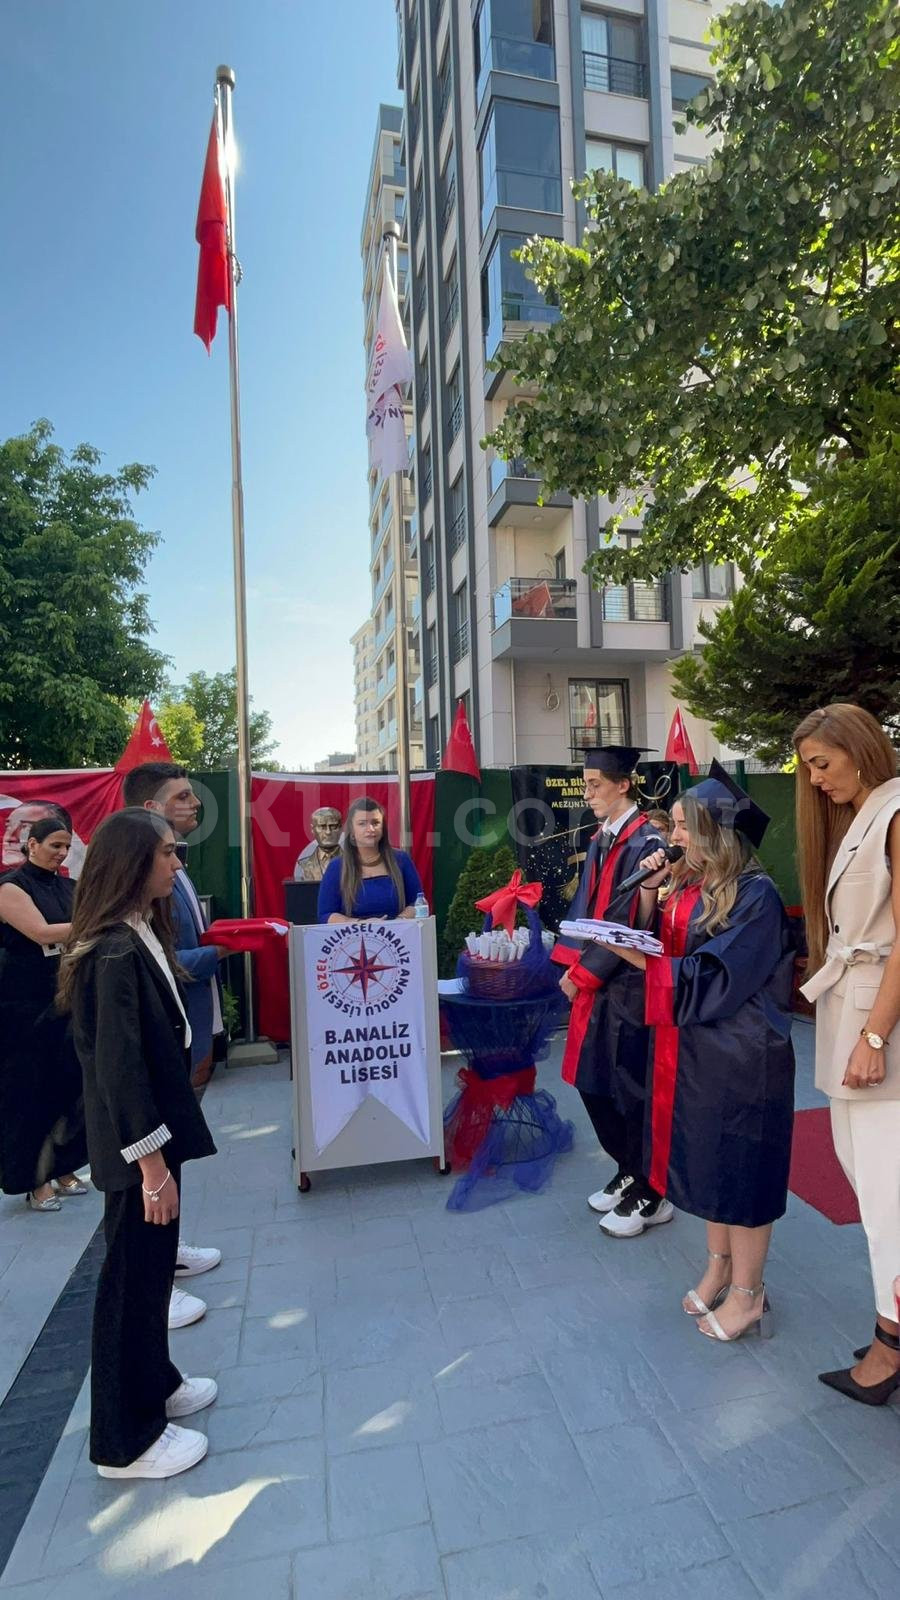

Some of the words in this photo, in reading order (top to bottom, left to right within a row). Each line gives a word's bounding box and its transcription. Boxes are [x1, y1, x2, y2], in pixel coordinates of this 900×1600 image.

[545, 776, 569, 788] ÖZEL
[321, 923, 374, 955] BİLİMSEL
[376, 926, 411, 965] ANALİZ
[316, 958, 330, 991] ÖZEL
[322, 990, 361, 1018] LİSESİ
[365, 968, 411, 1017] ANADOLU
[325, 1021, 410, 1045] B.ANALİZ
[324, 1043, 411, 1065] ANADOLU
[340, 1061, 398, 1084] LİSESİ
